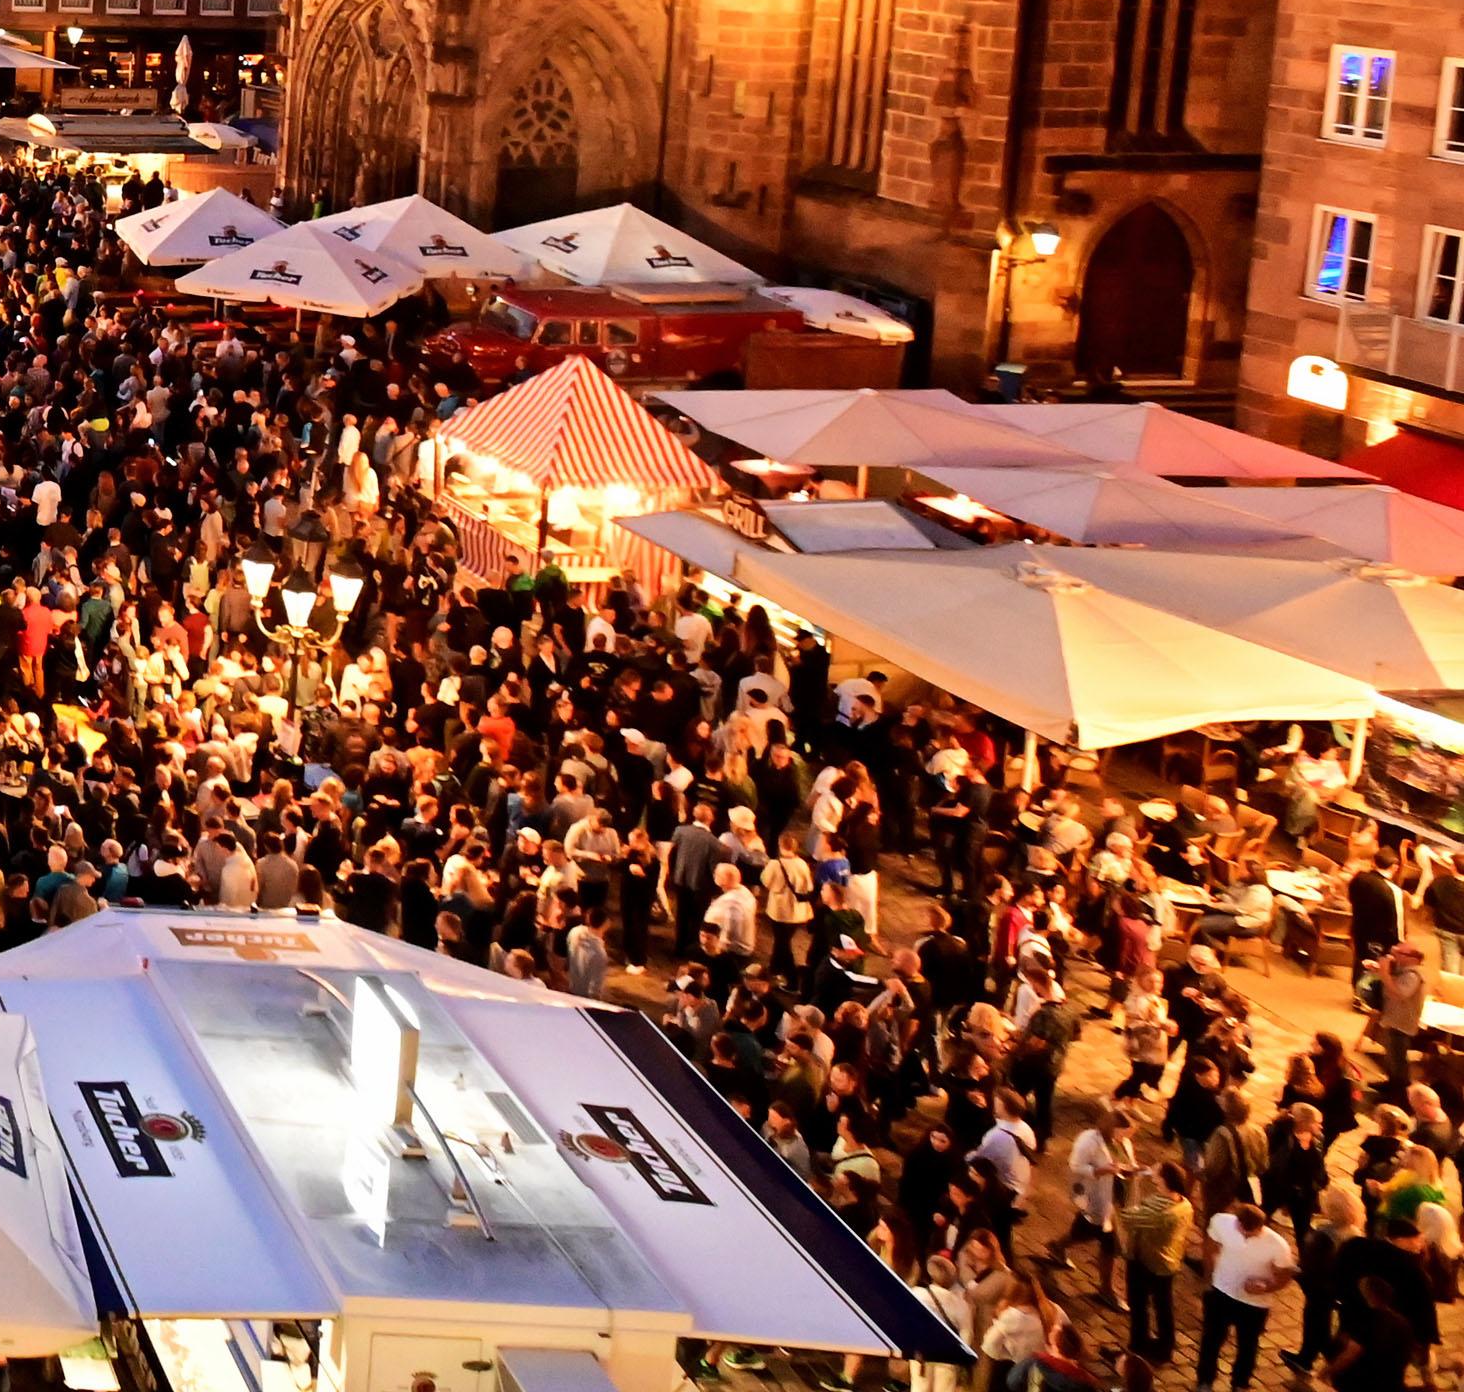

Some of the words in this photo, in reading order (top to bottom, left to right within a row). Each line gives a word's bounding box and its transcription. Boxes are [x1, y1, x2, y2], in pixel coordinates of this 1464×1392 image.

[724, 499, 768, 538] GRILL
[184, 932, 302, 949] Tucher
[93, 1089, 150, 1171] Tucher
[604, 1110, 694, 1196] Tucher
